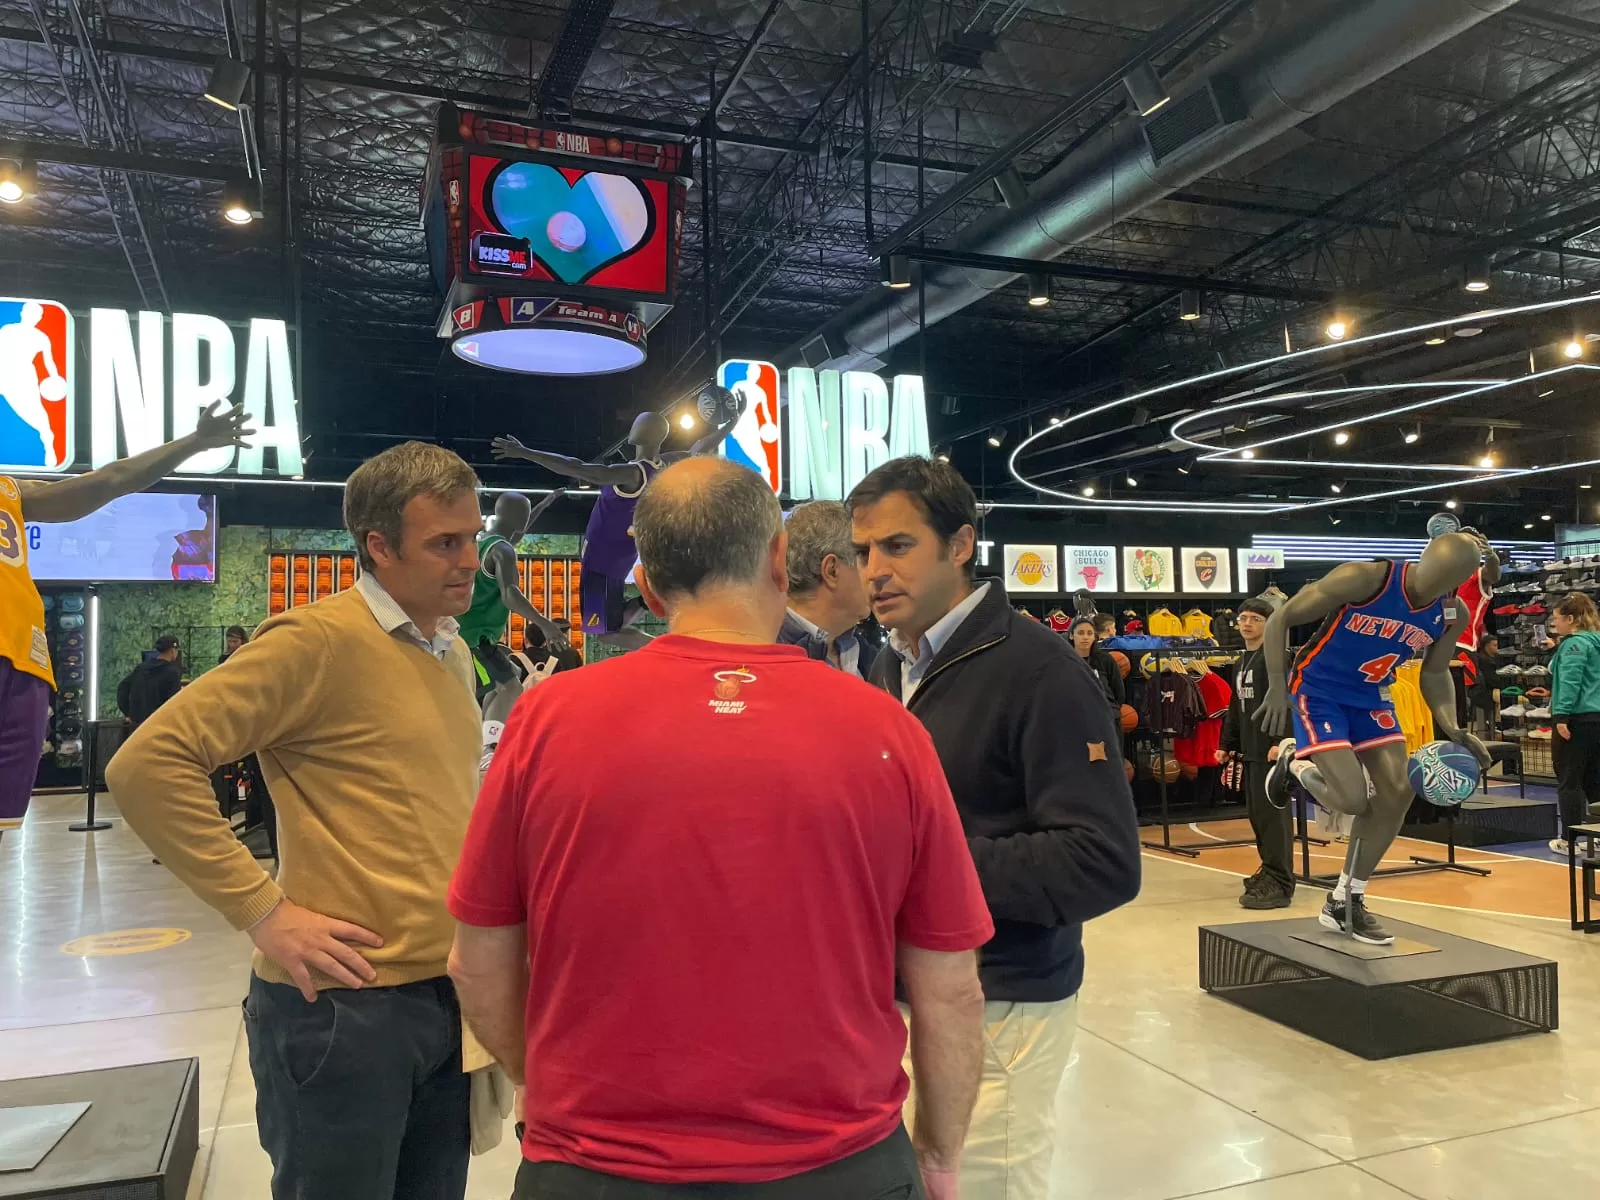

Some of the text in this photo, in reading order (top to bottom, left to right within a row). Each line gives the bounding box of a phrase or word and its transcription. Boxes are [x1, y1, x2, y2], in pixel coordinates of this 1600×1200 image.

[567, 133, 590, 153] NBA
[459, 309, 471, 324] B
[516, 301, 534, 316] A
[558, 304, 603, 321] Team
[91, 306, 304, 475] NBA
[787, 366, 931, 501] NBA
[25, 525, 41, 550] e
[1073, 549, 1109, 557] CHICAGO
[1011, 559, 1053, 577] LAKERS
[1345, 612, 1404, 639] NEW
[1357, 652, 1401, 684] 4
[708, 699, 745, 708] MIAMI
[714, 705, 747, 714] HEAT
